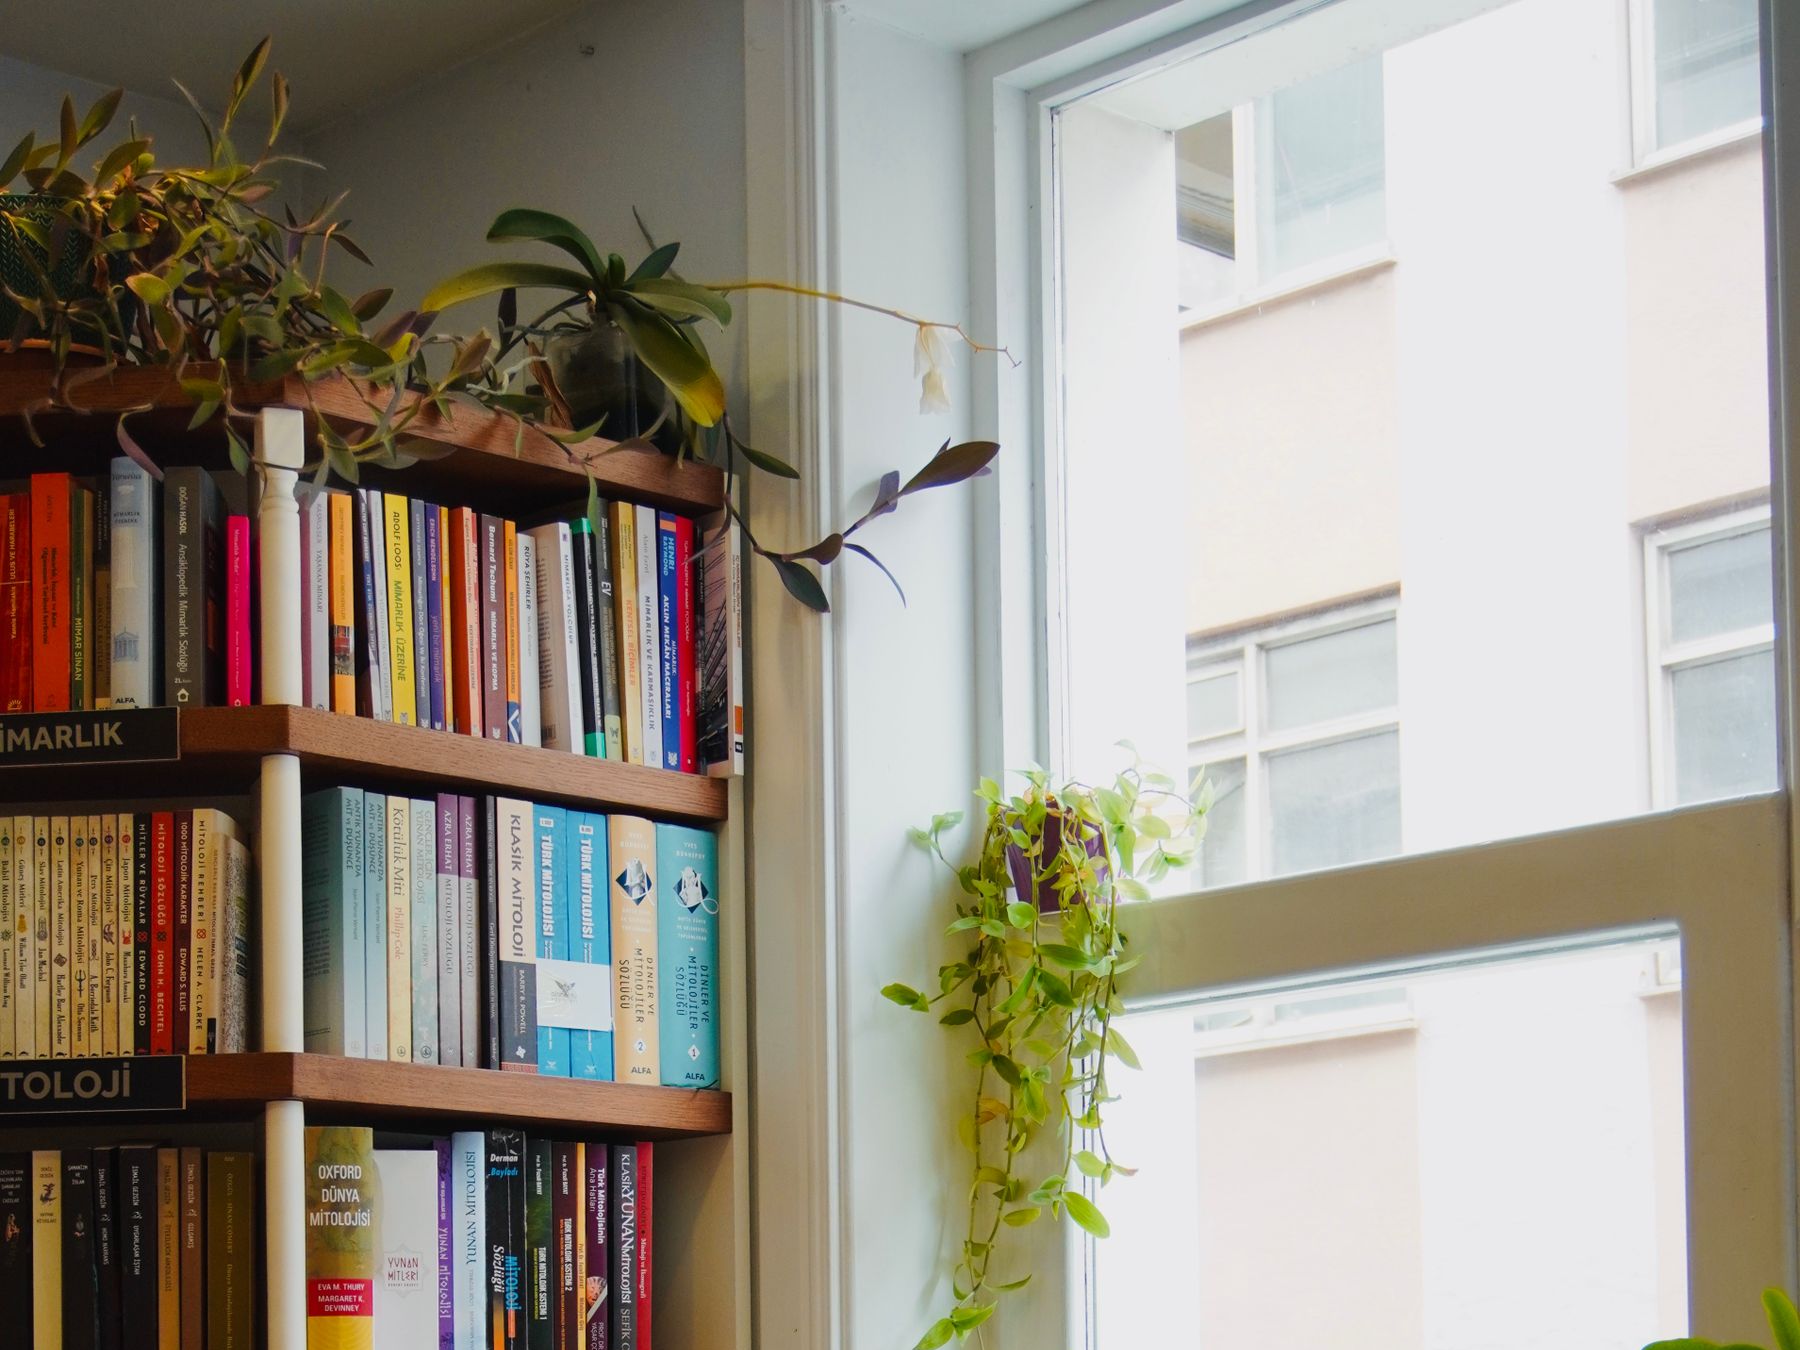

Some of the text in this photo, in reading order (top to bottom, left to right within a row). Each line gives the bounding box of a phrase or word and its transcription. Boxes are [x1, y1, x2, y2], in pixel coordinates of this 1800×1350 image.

[179, 486, 188, 536] DOĞAN HASOL
[489, 526, 498, 602] Bernard Tschumi
[524, 546, 532, 610] RÜYA ŞEHİRLER
[602, 581, 612, 596] EV
[176, 544, 188, 674] Ansiklopedik Mimarlık Sözlüğü
[663, 595, 671, 626] AKLIN
[74, 618, 83, 649] MİMAR
[392, 580, 406, 682] MİMARLIK ÜZERİNE
[664, 628, 672, 658] MEKÂN
[74, 652, 83, 681] SİNAN
[492, 651, 498, 660] VE
[0, 721, 124, 752] İMARLIK
[392, 807, 407, 896] Kötülük Miti
[444, 810, 453, 870] AZRA ERHAT
[542, 835, 554, 868] TÜRK
[76, 860, 85, 886] Yunan
[122, 858, 132, 922] Japon Mitolojisi
[138, 824, 147, 924] MİTLER VE RÜYALAR
[158, 823, 166, 926] MİTOLOJİ SÖZLÜĞÜ
[511, 814, 526, 957] KLASİK MİTOLOJİ
[77, 888, 83, 897] ve
[542, 870, 554, 936] MİTOLOJİSİ
[76, 926, 86, 964] Mitolojisi
[444, 878, 455, 974] MİTOLOJİ SÖZLÜĞÜ
[157, 979, 164, 988] H.
[618, 960, 632, 1010] SÖZLÜĞÜ
[634, 948, 646, 1023] MİTOLOJİLER
[675, 967, 688, 1016] SÖZLÜĞÜ
[688, 956, 700, 1030] MİTOLOJİLER
[648, 1003, 656, 1016] VE
[702, 1010, 710, 1024] VE
[638, 1041, 644, 1050] 2
[0, 1062, 131, 1100] TOLOJİ
[631, 1066, 652, 1074] ALFA
[685, 1072, 706, 1080] ALFA
[318, 1164, 362, 1180] OXFORD
[464, 1151, 478, 1216] MİTOLOJİSİ
[588, 1168, 597, 1212] Ana Hatları
[321, 1188, 360, 1202] DÜNYA
[596, 1168, 606, 1244] Türk Mitolojisinin
[310, 1208, 370, 1227] MİTOLOJİSİ
[620, 1154, 635, 1304] KLASİK YUNAN MİTOLOJİSİ
[464, 1220, 476, 1264] YUNAN
[388, 1258, 418, 1268] YUNAN
[492, 1244, 506, 1293] Sözlüğü
[318, 1283, 331, 1291] EVA
[343, 1283, 365, 1291] THURY
[318, 1295, 365, 1303] MARGARET K.
[324, 1304, 360, 1312] DEVINNEY
